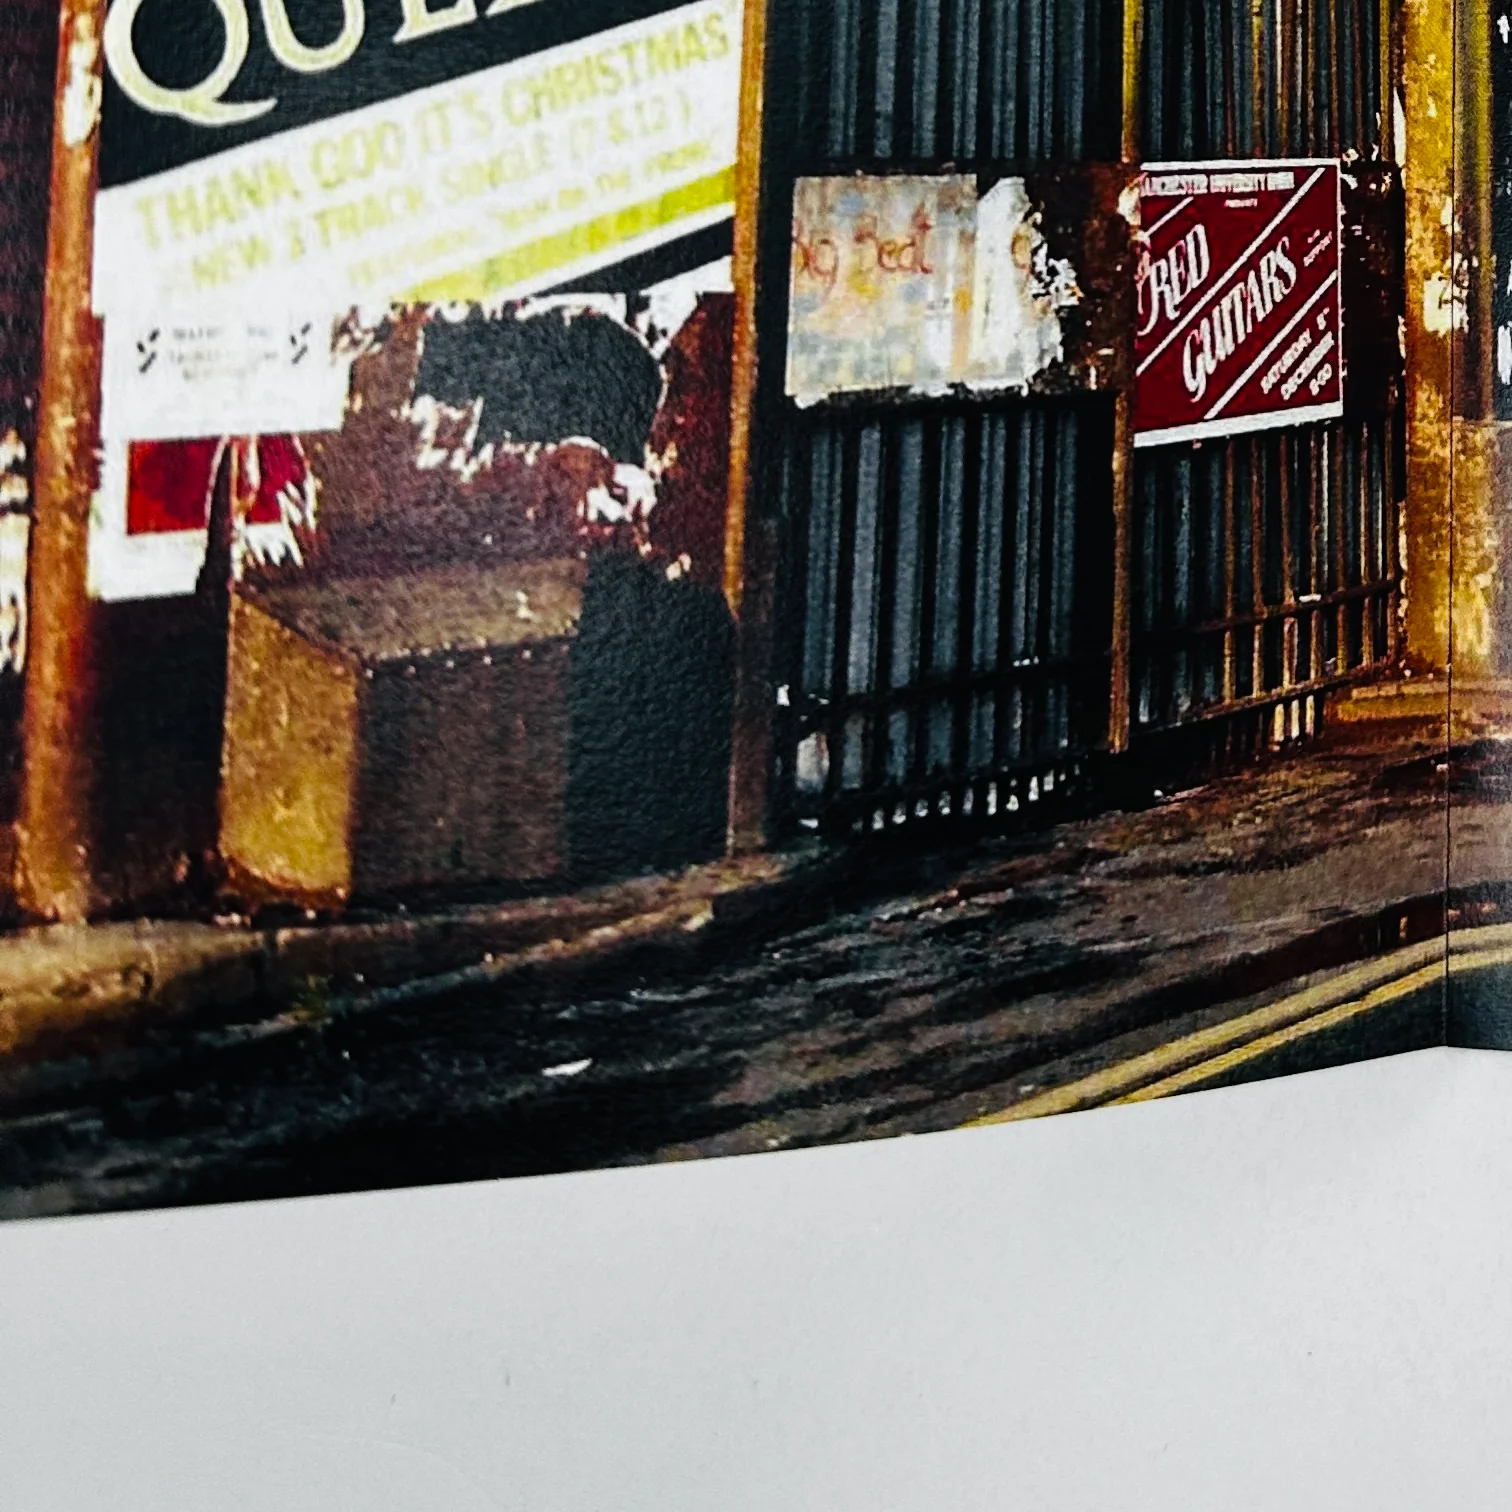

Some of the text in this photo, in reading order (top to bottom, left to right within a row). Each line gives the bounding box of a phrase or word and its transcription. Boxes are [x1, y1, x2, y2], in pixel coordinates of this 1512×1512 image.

[136, 156, 304, 250] THANK
[309, 119, 406, 191] GOD
[501, 14, 731, 129] CHRISTMAS
[1136, 223, 1211, 336] RED
[1182, 235, 1297, 404] GUITARS
